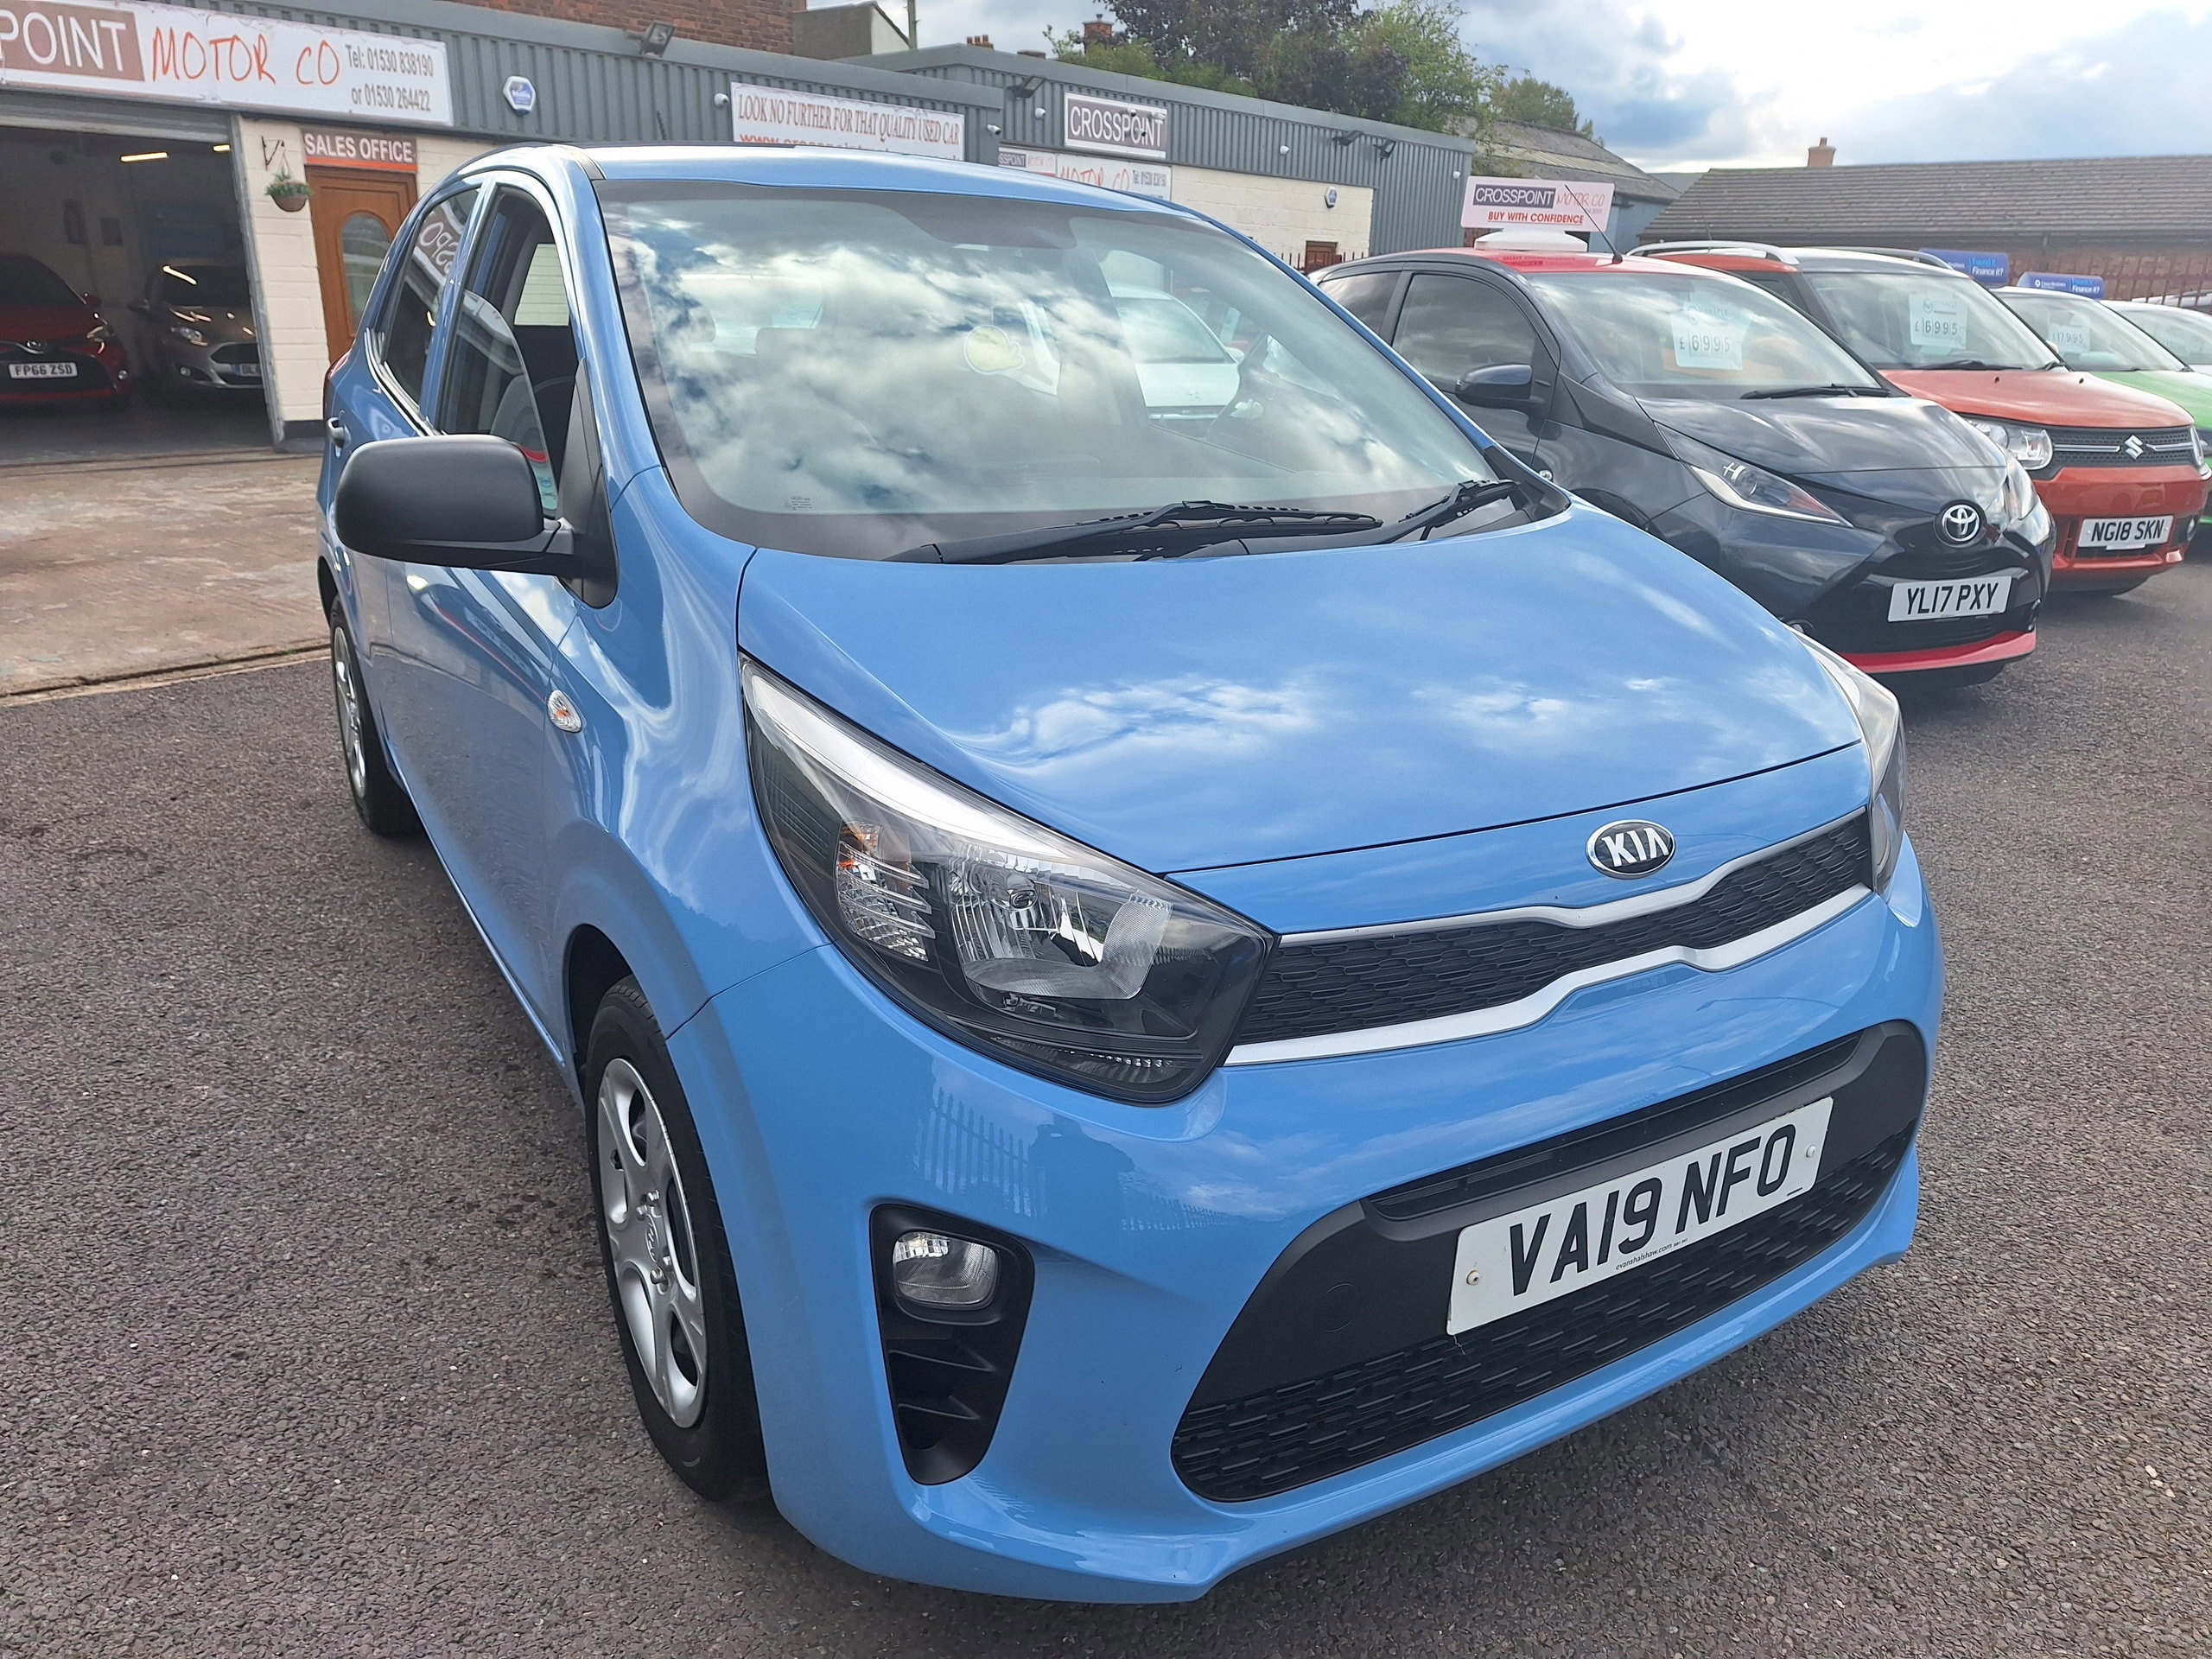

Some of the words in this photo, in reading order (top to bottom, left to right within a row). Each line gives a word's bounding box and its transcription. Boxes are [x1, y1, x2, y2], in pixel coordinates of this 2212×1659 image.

[152, 27, 276, 84] MOTOR
[296, 40, 340, 85] CO
[346, 44, 365, 69] Tel:
[367, 47, 397, 73] 01530
[399, 50, 433, 77] 838190
[352, 88, 363, 105] or
[365, 84, 394, 109] 01530
[397, 87, 430, 111] 264422
[739, 94, 767, 122] LOOK
[771, 99, 785, 124] NO
[786, 101, 832, 129] FURTHER
[833, 107, 854, 132] FOR
[855, 110, 879, 136] THAT
[880, 114, 917, 143] QUALITY
[918, 118, 941, 143] USED
[943, 121, 959, 145] CAR
[1070, 105, 1164, 147] CROSSPOINT
[304, 133, 356, 158] SALES
[359, 138, 413, 163] OFFICE
[1475, 188, 1555, 206] CROSSPOINT
[1592, 194, 1605, 207] CO
[1488, 211, 1505, 221] BUY
[1507, 213, 1528, 222] WITH
[1530, 213, 1584, 224] CONFIDENCE
[1972, 266, 1995, 276] Finance
[1995, 268, 2005, 276] it?
[15, 365, 47, 376] FP66
[49, 364, 73, 375] ZSD
[2091, 521, 2133, 542] NG18
[2134, 519, 2164, 540] SKN
[1907, 585, 1954, 614] YL17
[1955, 582, 1999, 611] PXY
[1601, 827, 1669, 867] KIA
[1509, 1177, 1663, 1296] VA19
[1675, 1123, 1796, 1235] NFO
[1615, 1243, 1673, 1270] evanshalshaw.com
